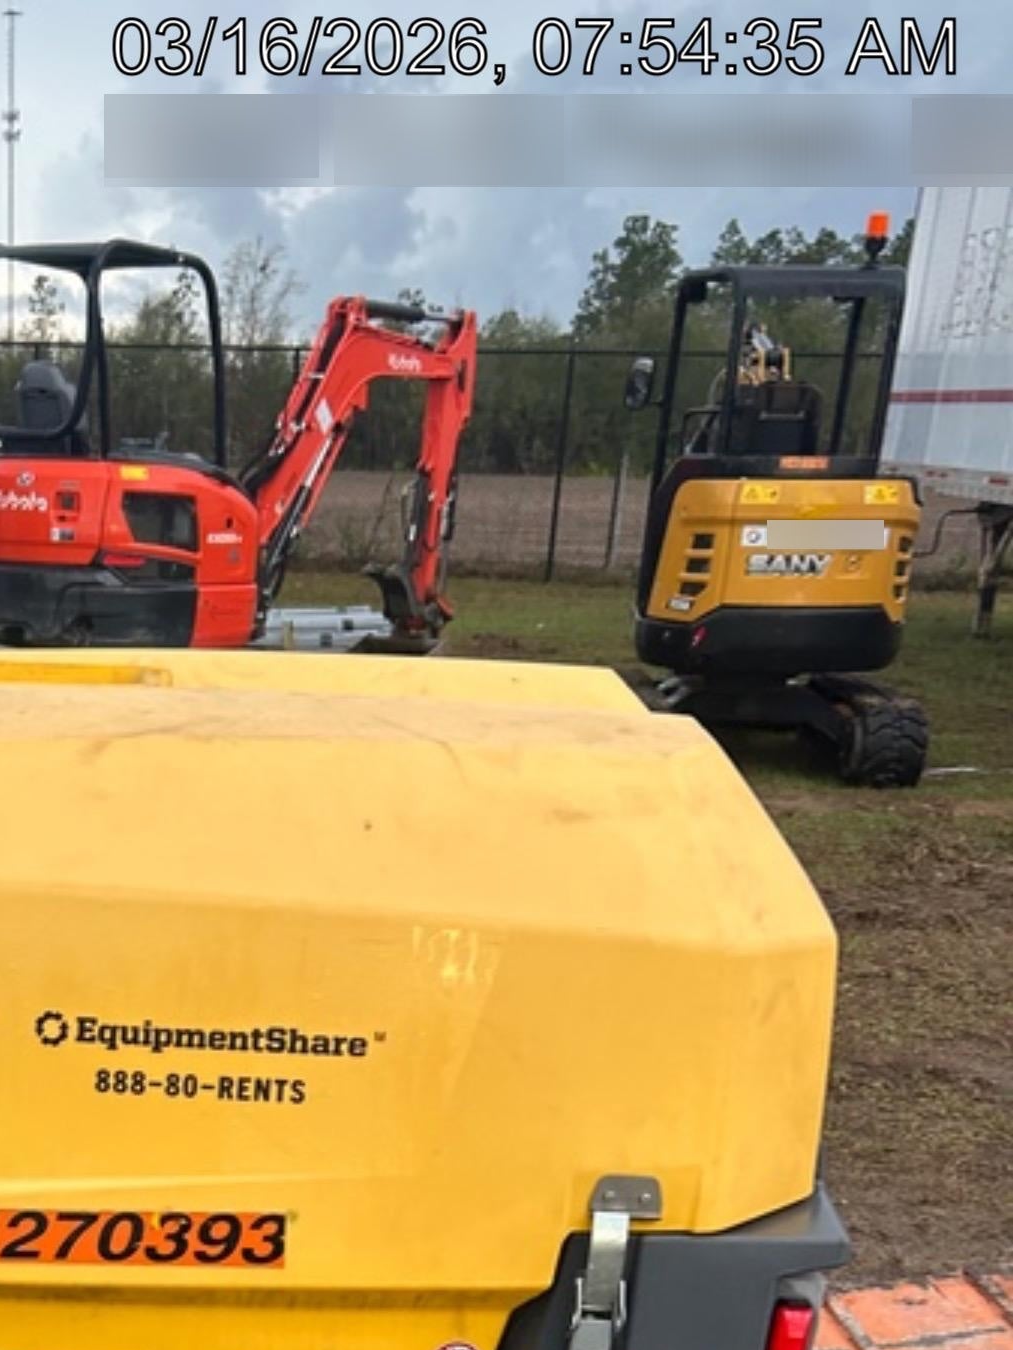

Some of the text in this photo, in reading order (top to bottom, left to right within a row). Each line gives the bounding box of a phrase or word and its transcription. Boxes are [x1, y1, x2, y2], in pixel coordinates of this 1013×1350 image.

[747, 553, 832, 578] SANY
[75, 1015, 368, 1057] EquipmentShare
[94, 1068, 306, 1104] 888-80-RENTS
